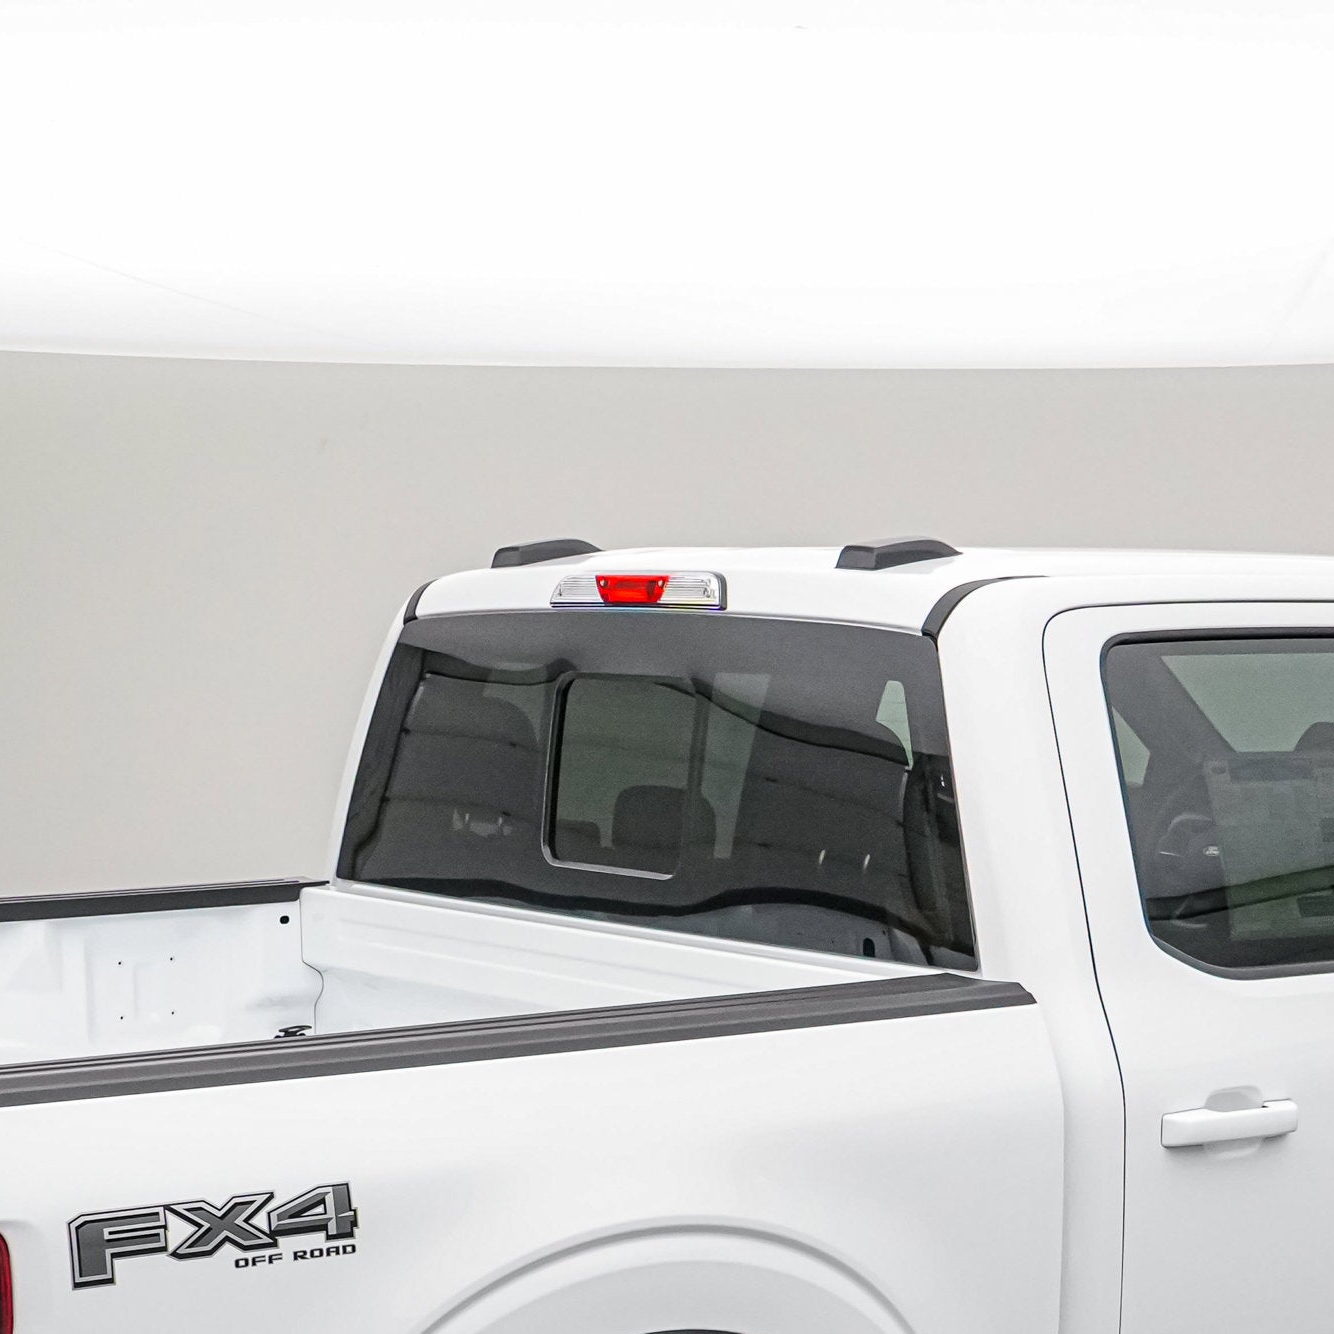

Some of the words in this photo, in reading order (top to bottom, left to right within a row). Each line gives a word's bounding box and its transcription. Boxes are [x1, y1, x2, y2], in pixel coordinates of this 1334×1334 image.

[68, 1181, 359, 1290] FX4
[234, 1253, 283, 1269] OFF
[293, 1244, 357, 1262] ROAD
